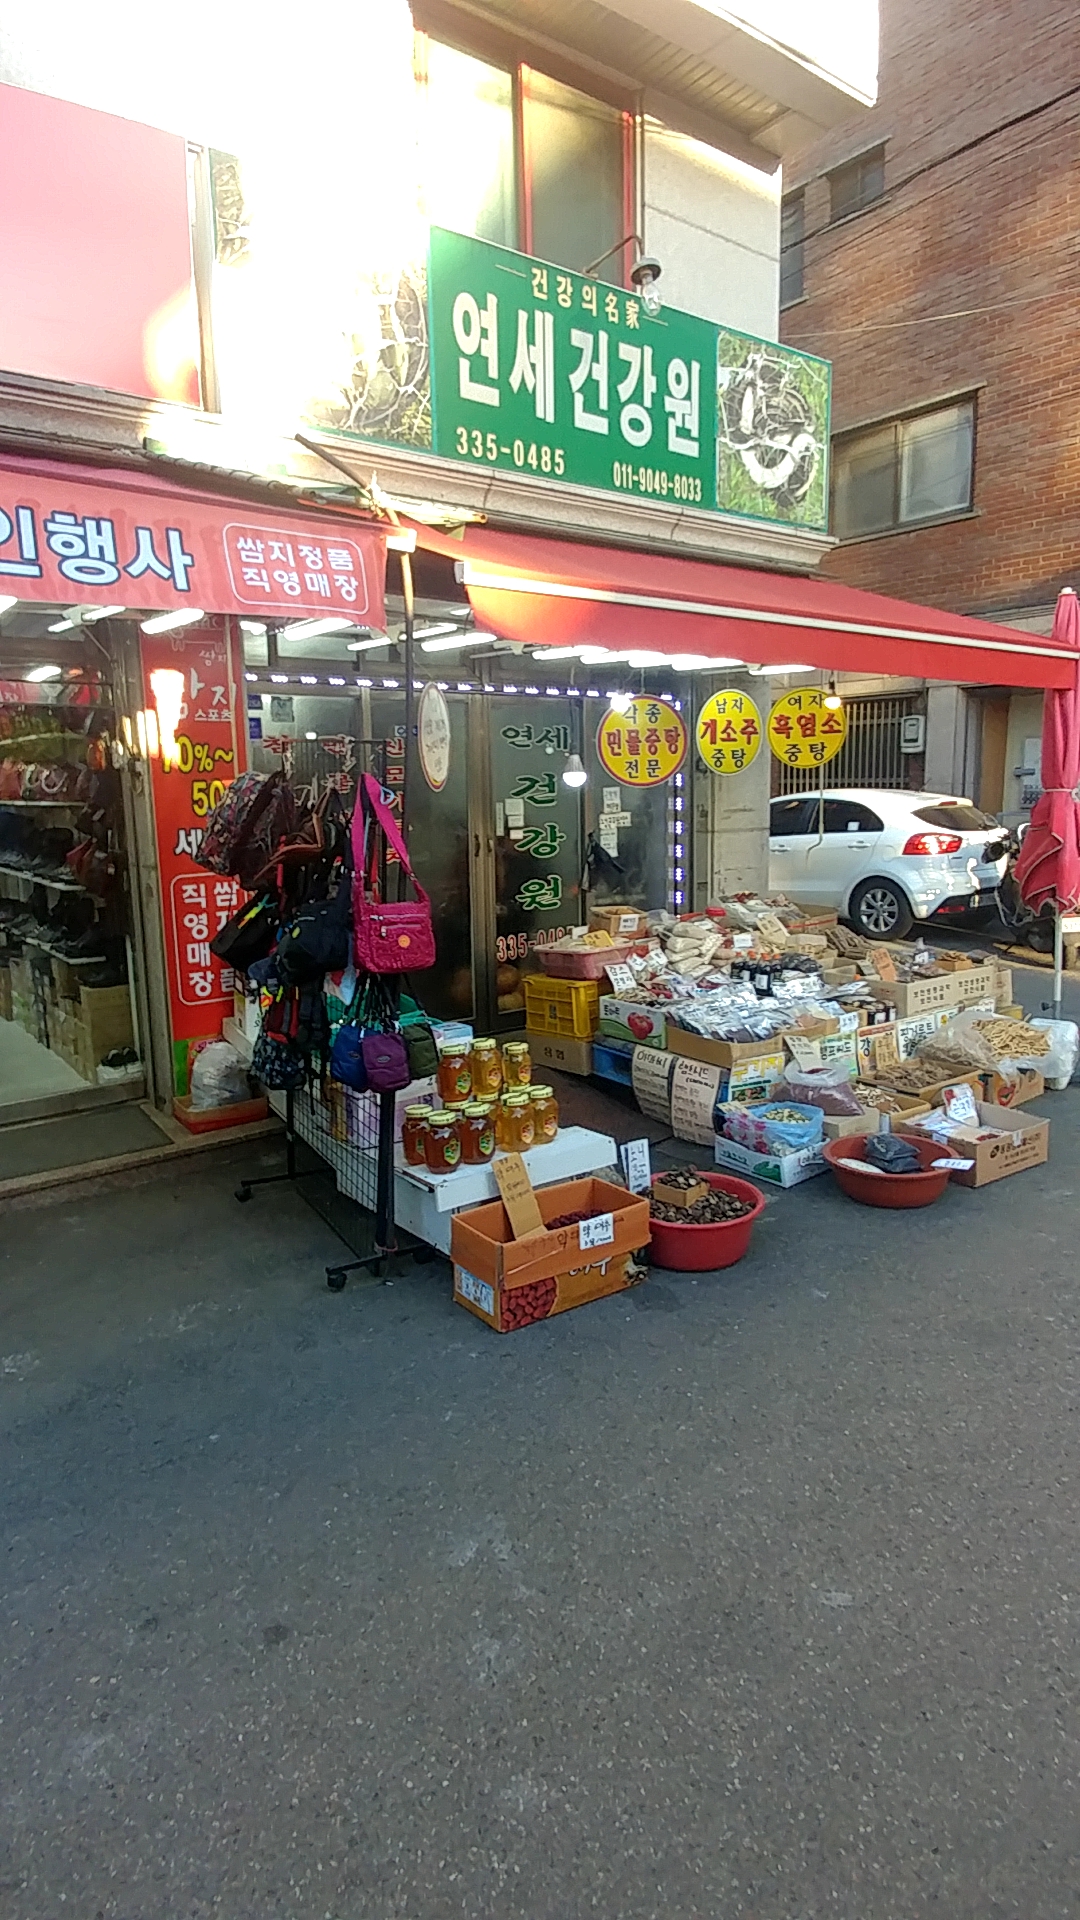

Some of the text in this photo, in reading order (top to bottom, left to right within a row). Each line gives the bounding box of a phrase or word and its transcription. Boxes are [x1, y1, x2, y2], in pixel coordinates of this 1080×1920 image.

[452, 291, 701, 459] 연세건강원
[455, 426, 566, 477] 335-0485
[612, 460, 702, 502] 011-9049-8033
[236, 535, 355, 572] 쌈지정품
[241, 566, 359, 602] 직영매장
[715, 698, 745, 715] 남자
[787, 694, 824, 711] 여자
[501, 726, 569, 751] 연세
[605, 725, 681, 757] 민물중탕
[771, 712, 845, 739] 흑염소
[624, 759, 662, 779] 전문
[711, 748, 747, 769] 중탕
[783, 744, 828, 763] 중탕
[180, 883, 215, 997] 직영매장
[496, 926, 575, 963] 335-048
